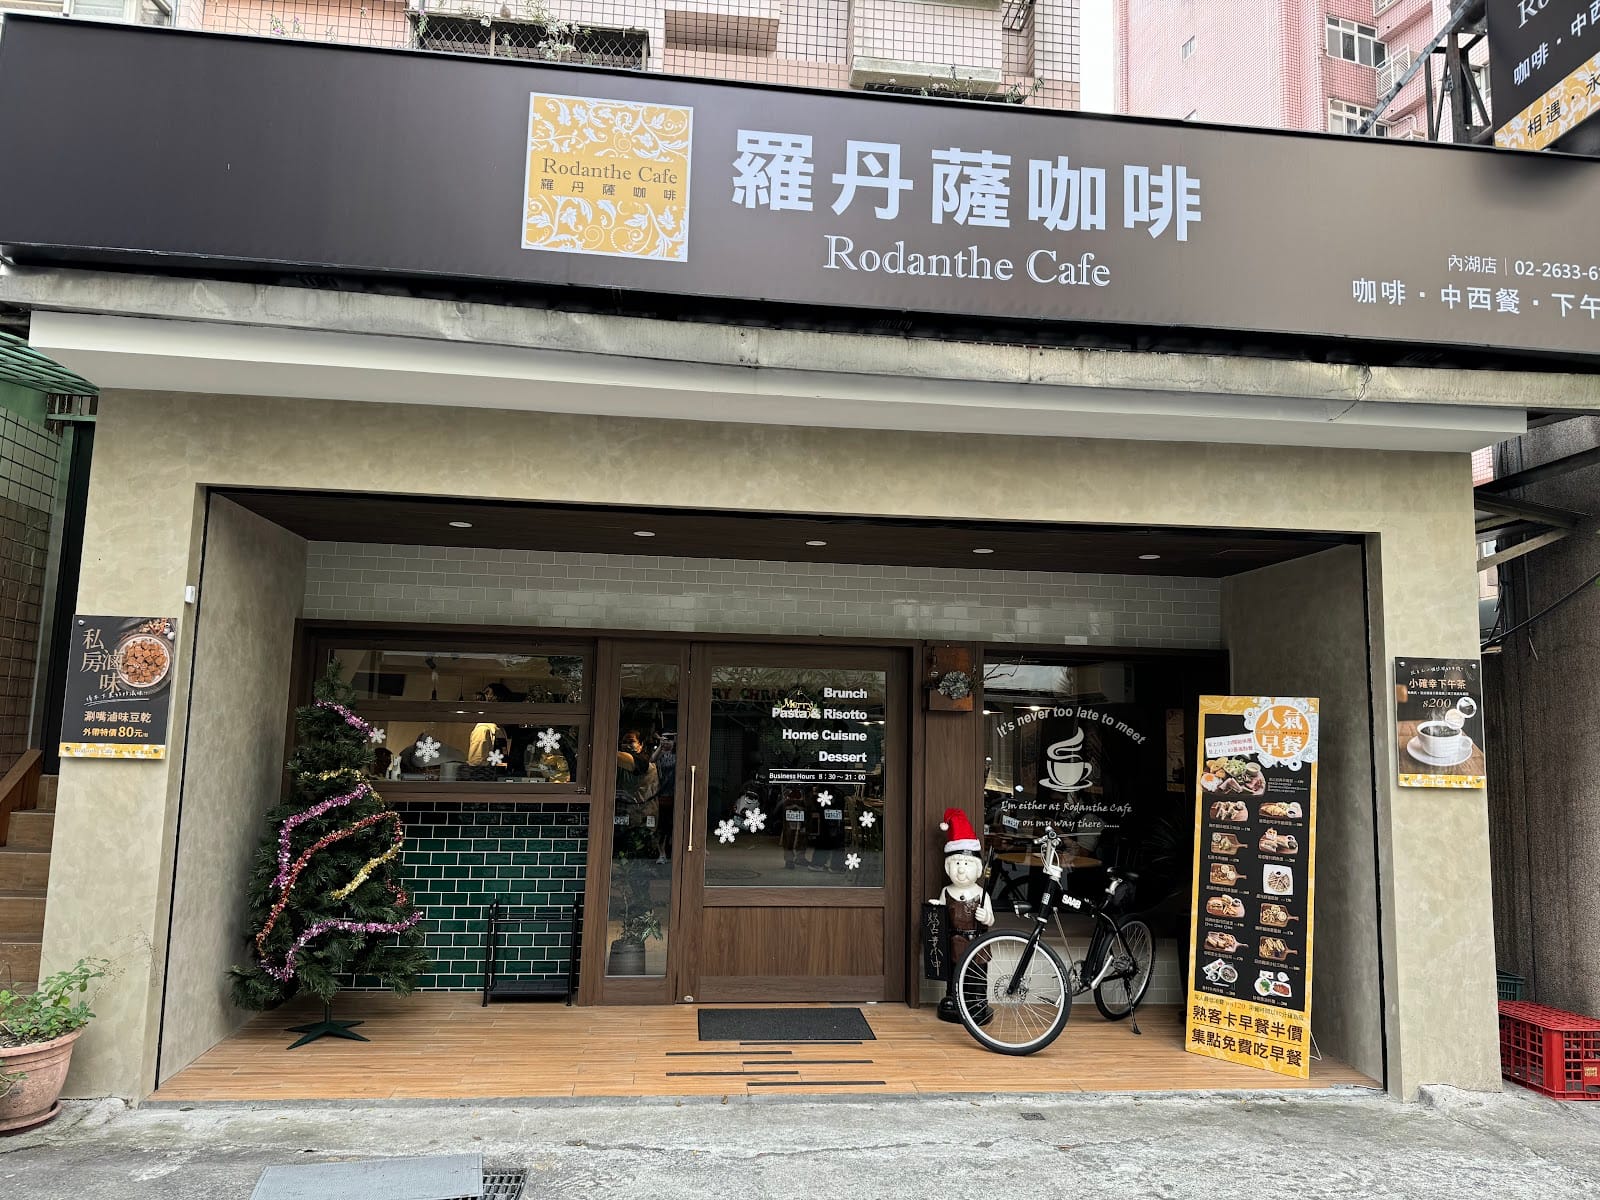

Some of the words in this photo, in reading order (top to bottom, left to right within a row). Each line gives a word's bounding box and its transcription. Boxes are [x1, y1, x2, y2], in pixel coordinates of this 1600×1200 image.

[542, 158, 632, 181] Rodanthe
[638, 166, 678, 184] Cafe
[540, 178, 677, 201] 羅丹薩咖啡
[732, 129, 1202, 242] 羅丹薩咖啡
[824, 235, 1015, 282] Rodanthe
[1026, 250, 1111, 288] Cafe
[1448, 254, 1497, 274] 內湖店
[823, 687, 868, 699] Brunch
[1408, 678, 1467, 690] 小確幸下午茶
[771, 707, 808, 719] Pasta
[810, 709, 821, 720] &
[823, 708, 868, 720] Risotto
[996, 721, 1016, 739] It's
[1016, 708, 1051, 727] never
[1053, 706, 1073, 717] too
[1076, 706, 1099, 721] late
[1101, 713, 1114, 726] to
[1115, 721, 1147, 745] meet
[782, 729, 819, 740] Home
[821, 729, 868, 741] Cuisine
[818, 751, 867, 763] Dessert
[769, 772, 796, 780] Business
[1018, 800, 1047, 811] either
[1048, 803, 1061, 811] at
[1062, 802, 1108, 814] Rodanthe
[1109, 803, 1133, 817] Cafe
[1054, 820, 1075, 832] way
[1077, 818, 1102, 828] there
[1192, 1005, 1303, 1043] 熟客卡早餐半價
[1192, 1028, 1302, 1067] 集點免費吃早餐
